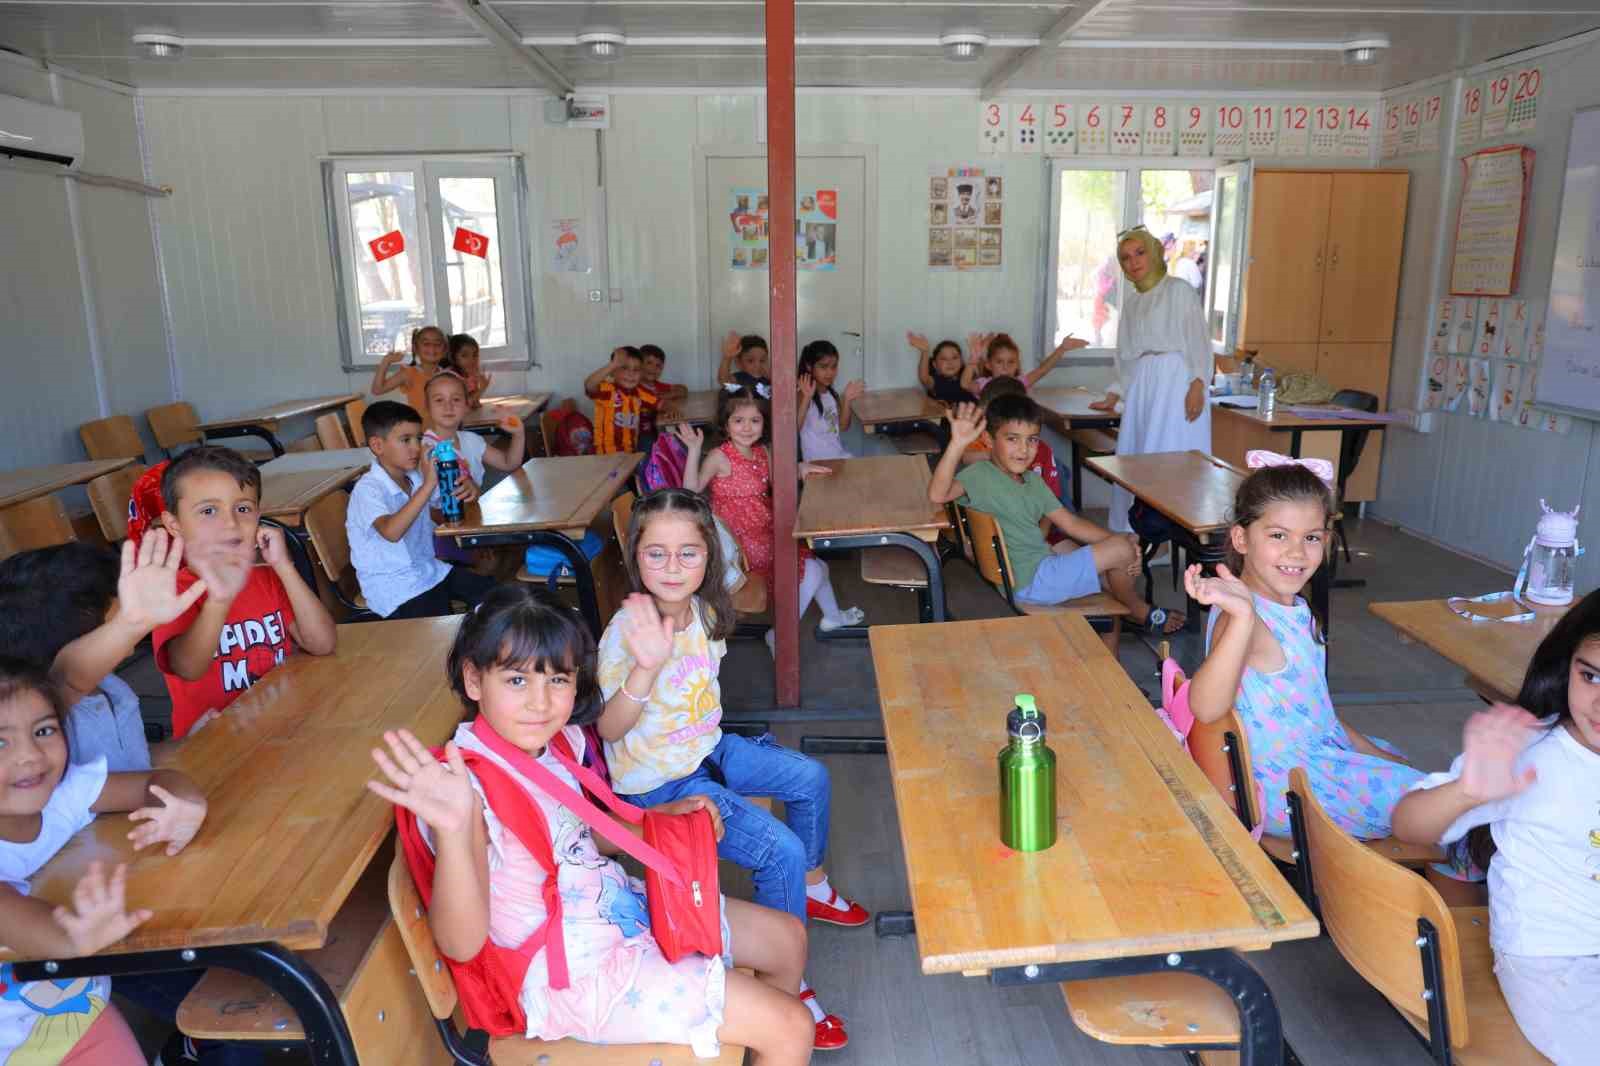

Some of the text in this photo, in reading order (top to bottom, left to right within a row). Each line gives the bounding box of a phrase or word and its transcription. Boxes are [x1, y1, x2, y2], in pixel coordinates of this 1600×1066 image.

[1464, 69, 1541, 114] 18 19 20
[987, 103, 1371, 130] 3 4 5 6 7 8 9 10 11 12 13 14
[1386, 97, 1440, 128] 15 16 17
[213, 610, 285, 658] PIDE
